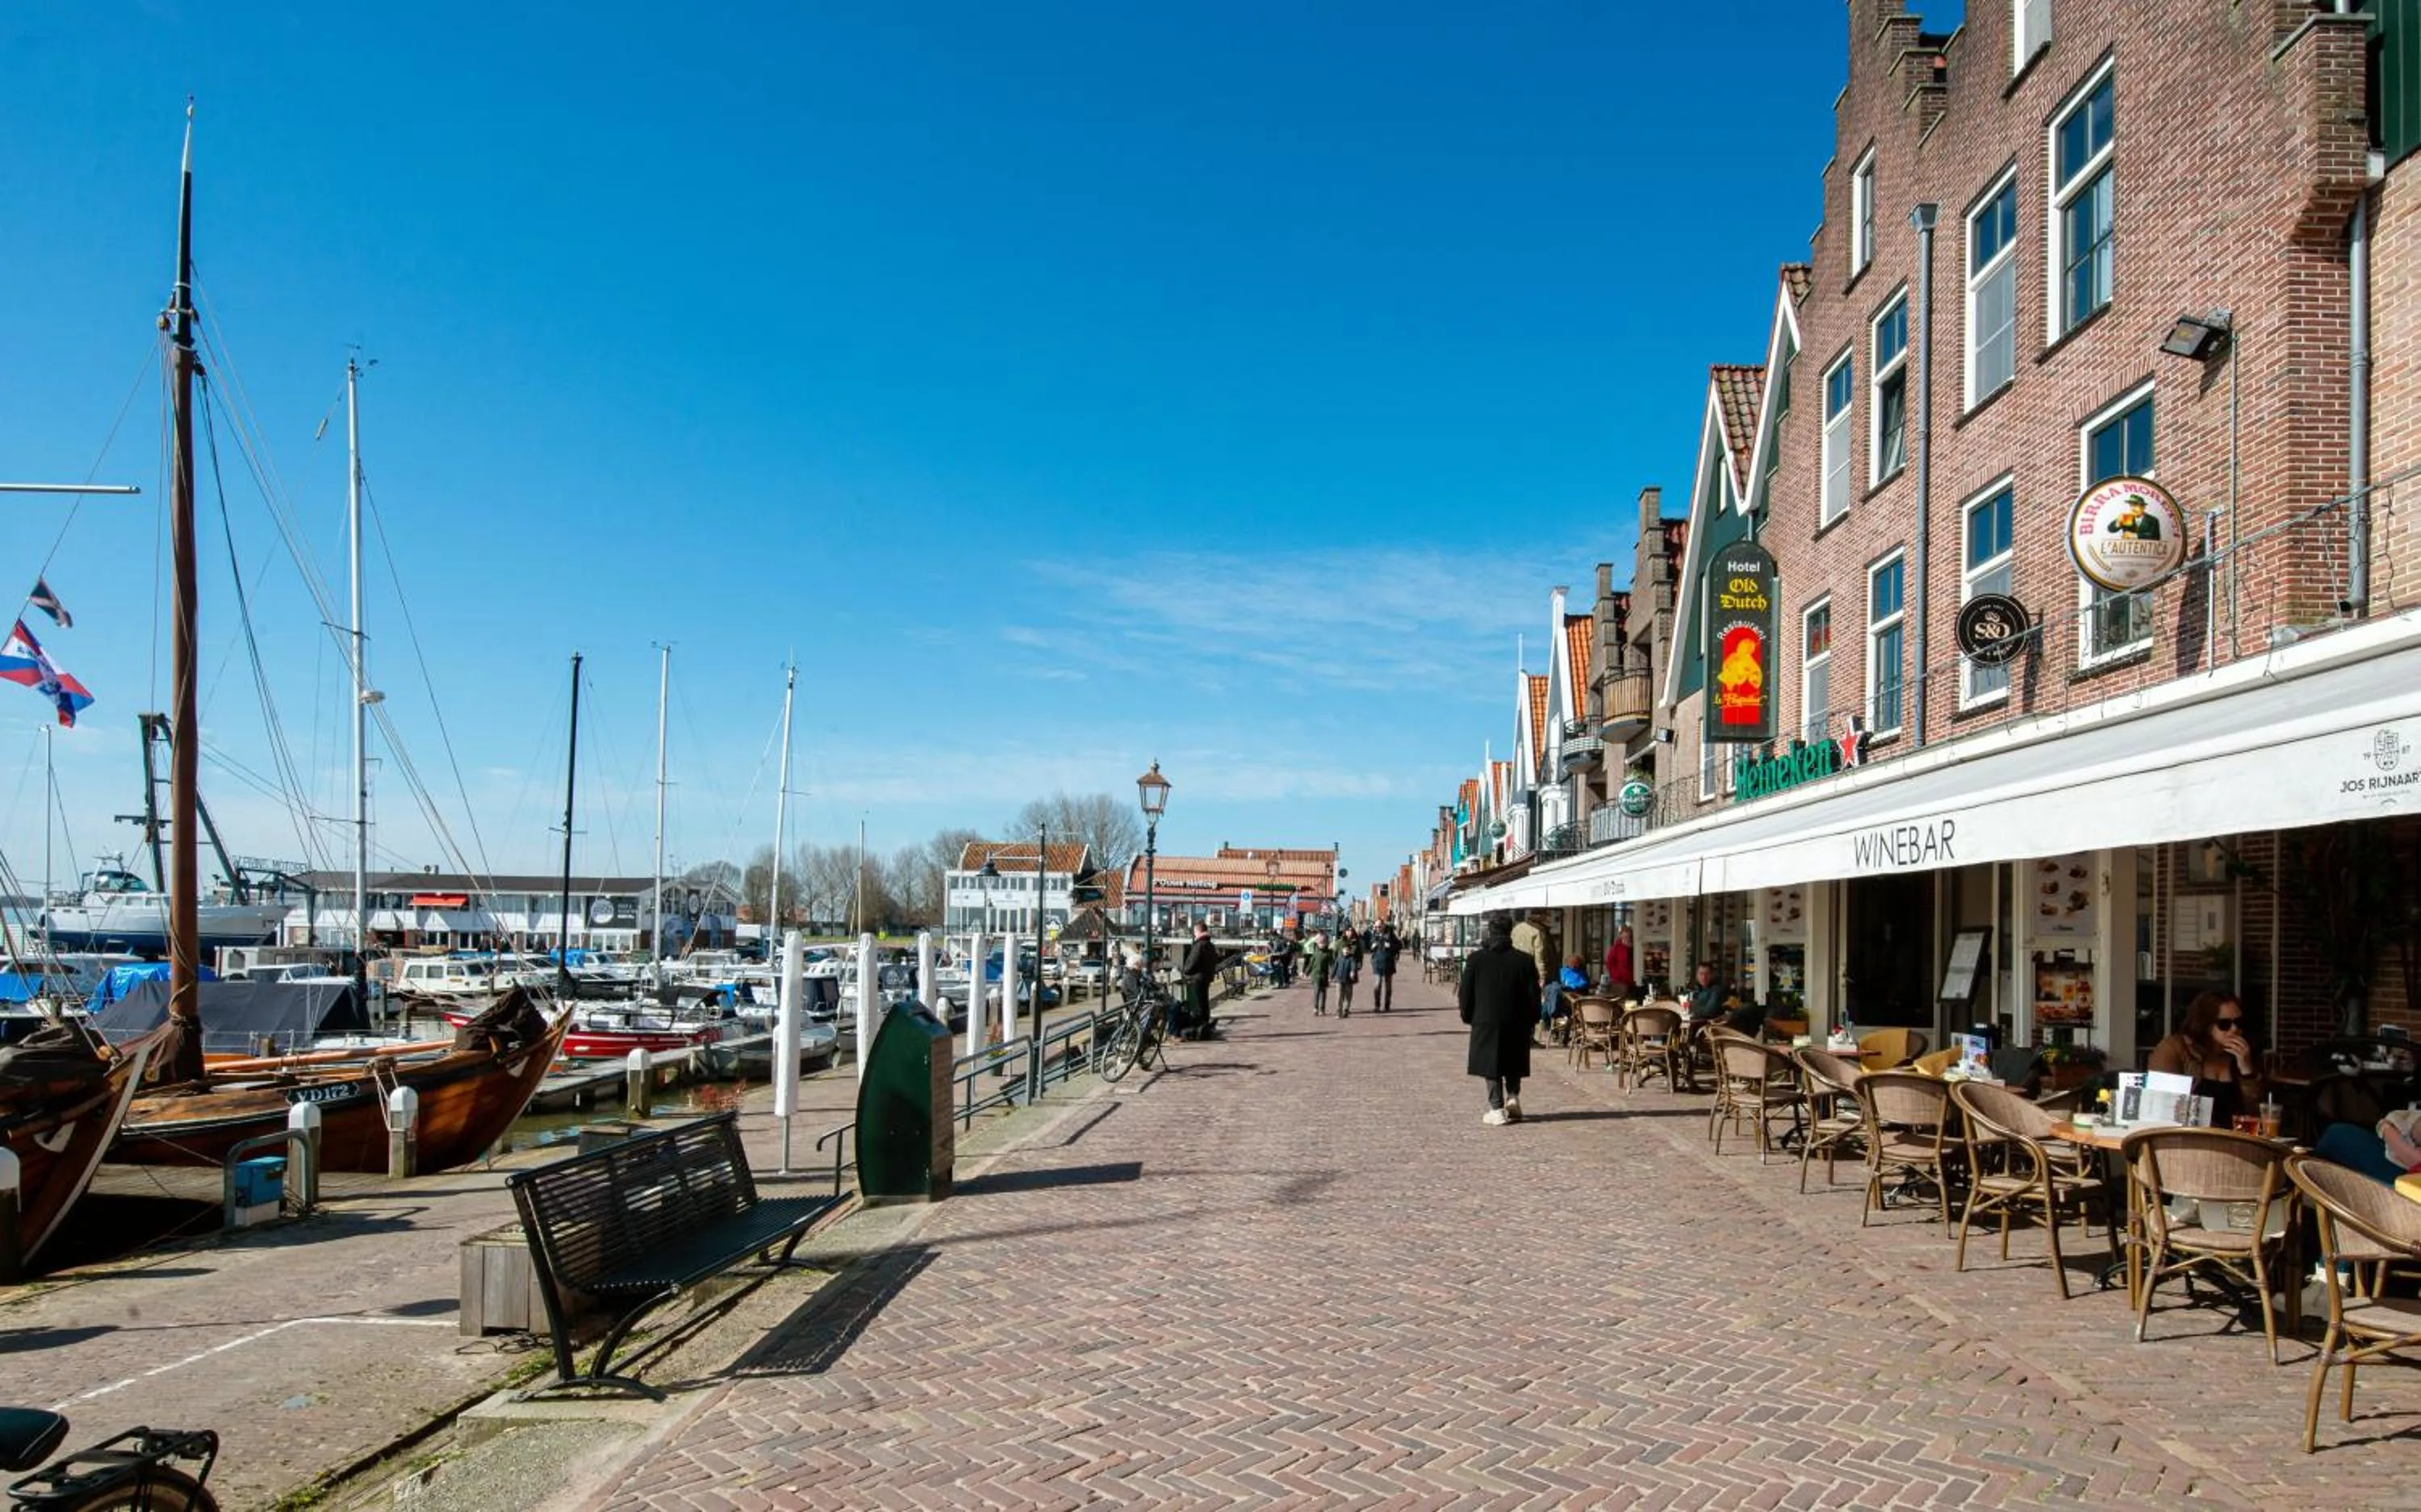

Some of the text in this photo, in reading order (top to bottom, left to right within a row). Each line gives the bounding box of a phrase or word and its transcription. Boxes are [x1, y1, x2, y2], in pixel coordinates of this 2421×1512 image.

[2079, 487, 2122, 536] BIRRA
[1728, 561, 1760, 572] Hotel
[1729, 578, 1758, 593] Old
[1720, 594, 1767, 612] Dutch
[1735, 738, 1831, 801] Heineken
[2340, 771, 2421, 793] JOS RIJNAAR
[1854, 819, 1955, 868] WINEBAR
